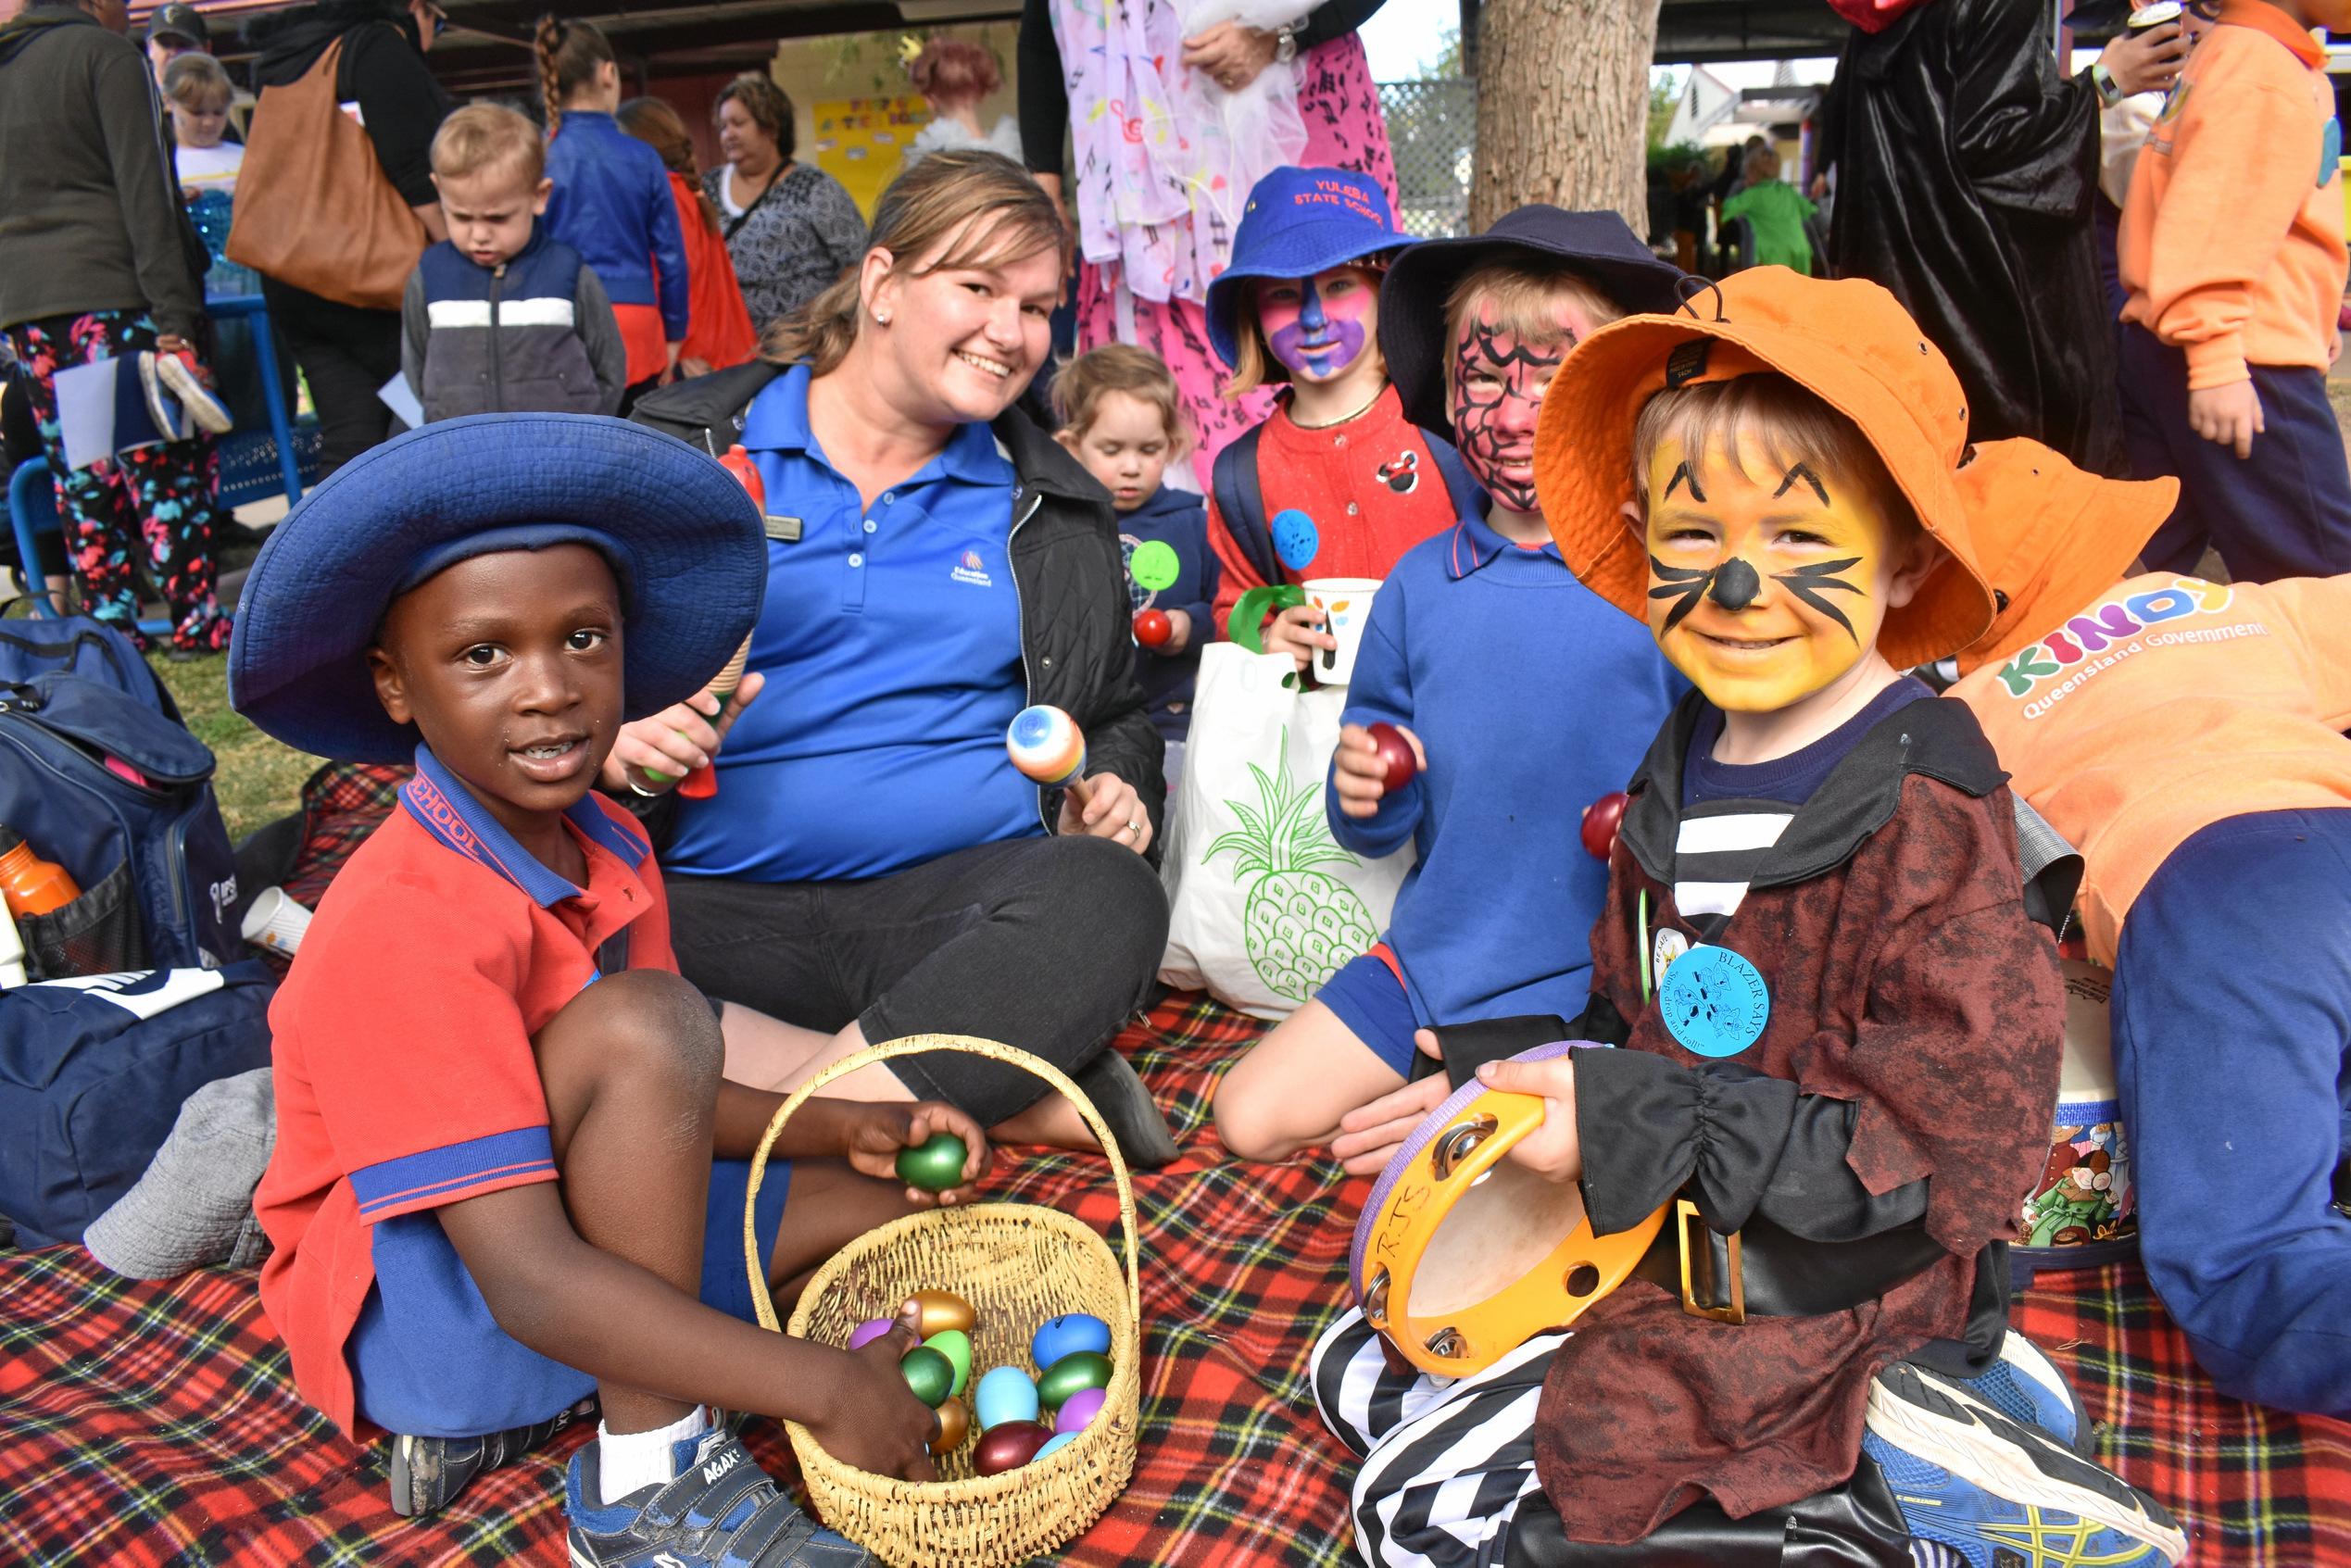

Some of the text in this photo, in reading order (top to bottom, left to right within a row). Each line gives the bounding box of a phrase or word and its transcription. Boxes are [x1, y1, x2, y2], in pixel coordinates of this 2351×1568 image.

[1315, 180, 1370, 204] YULEBA
[1294, 193, 1384, 230] STATE SCHOOL
[950, 571, 992, 587] Queensland
[954, 566, 988, 580] Education
[1995, 578, 2234, 699] KINDY
[2023, 622, 2269, 720] Queensland Government
[1718, 951, 1765, 1037] BLAZER SAYS
[1665, 996, 1673, 1018] drop
[1670, 1020, 1684, 1035] and
